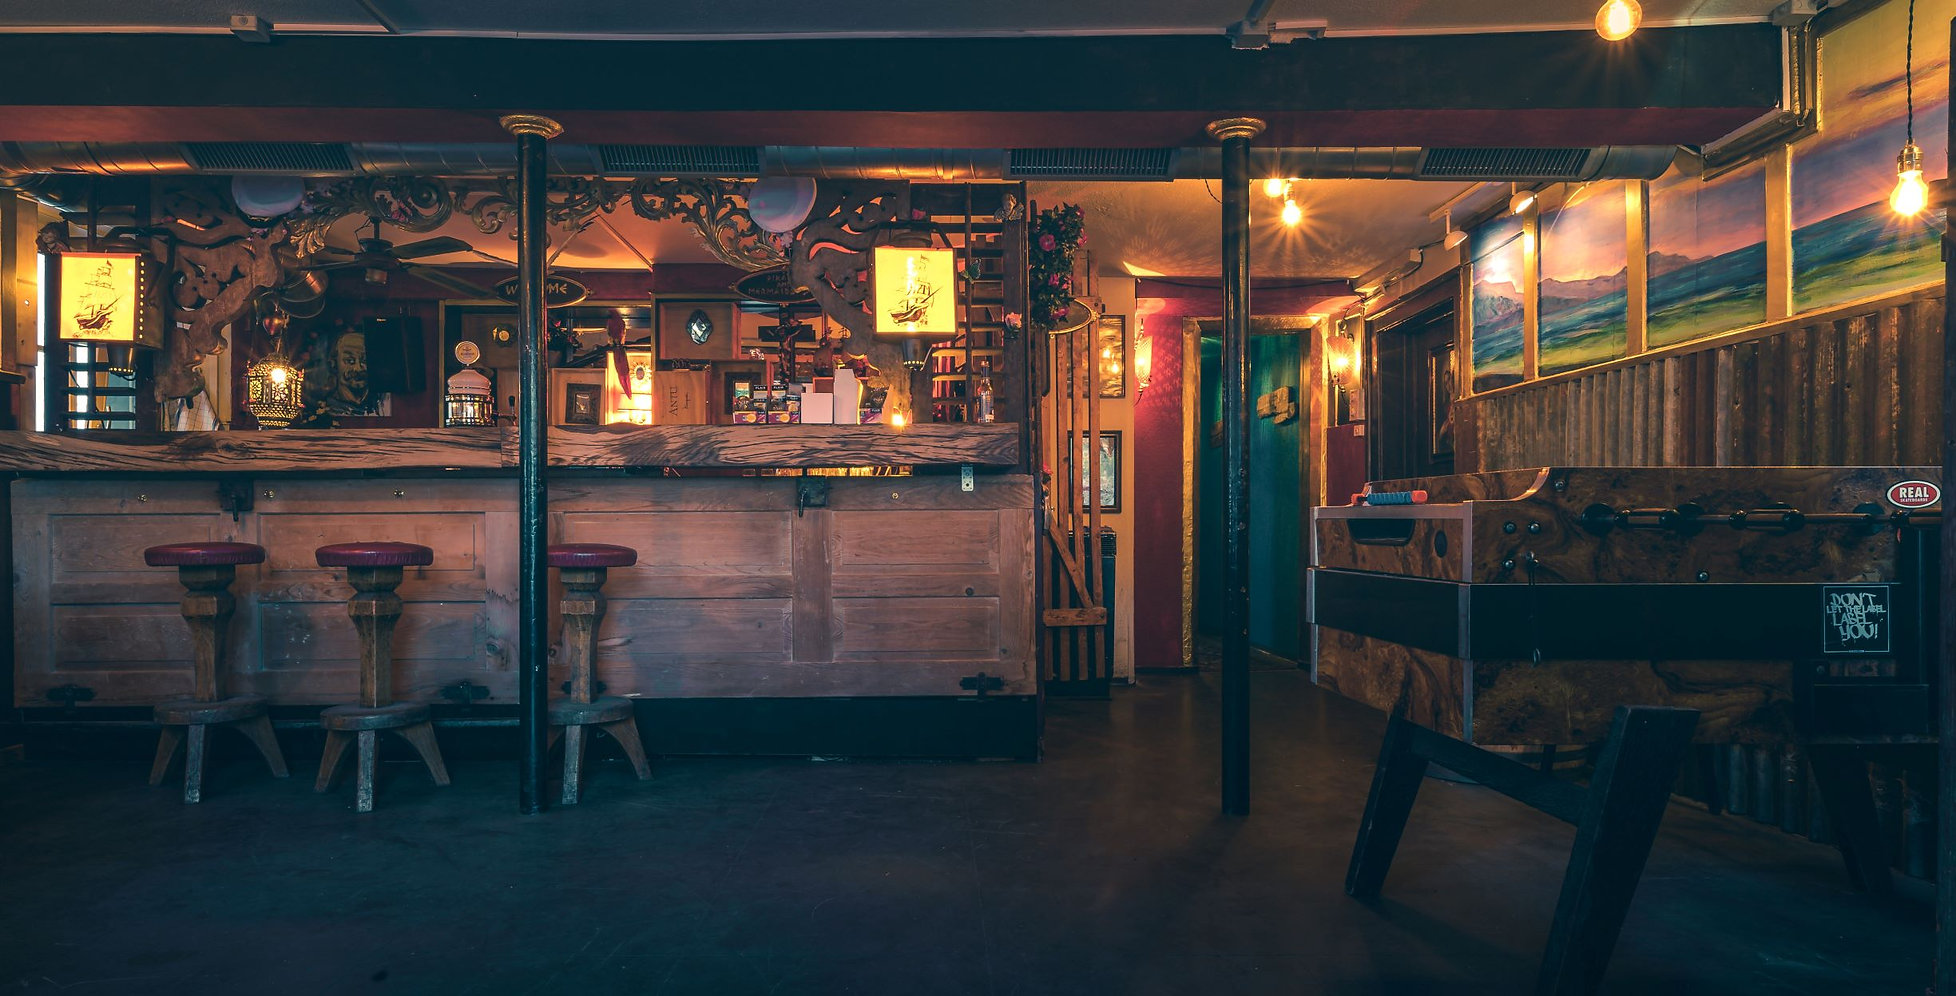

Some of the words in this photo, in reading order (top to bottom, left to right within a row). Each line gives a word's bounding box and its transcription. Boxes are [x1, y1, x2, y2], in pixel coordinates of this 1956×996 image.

[1899, 486, 1929, 498] REAL
[1826, 605, 1843, 614] LET
[1845, 605, 1862, 614] THE
[1862, 604, 1887, 613] LABEL
[1832, 611, 1873, 626] LABEL
[1838, 623, 1878, 641] YOU!
